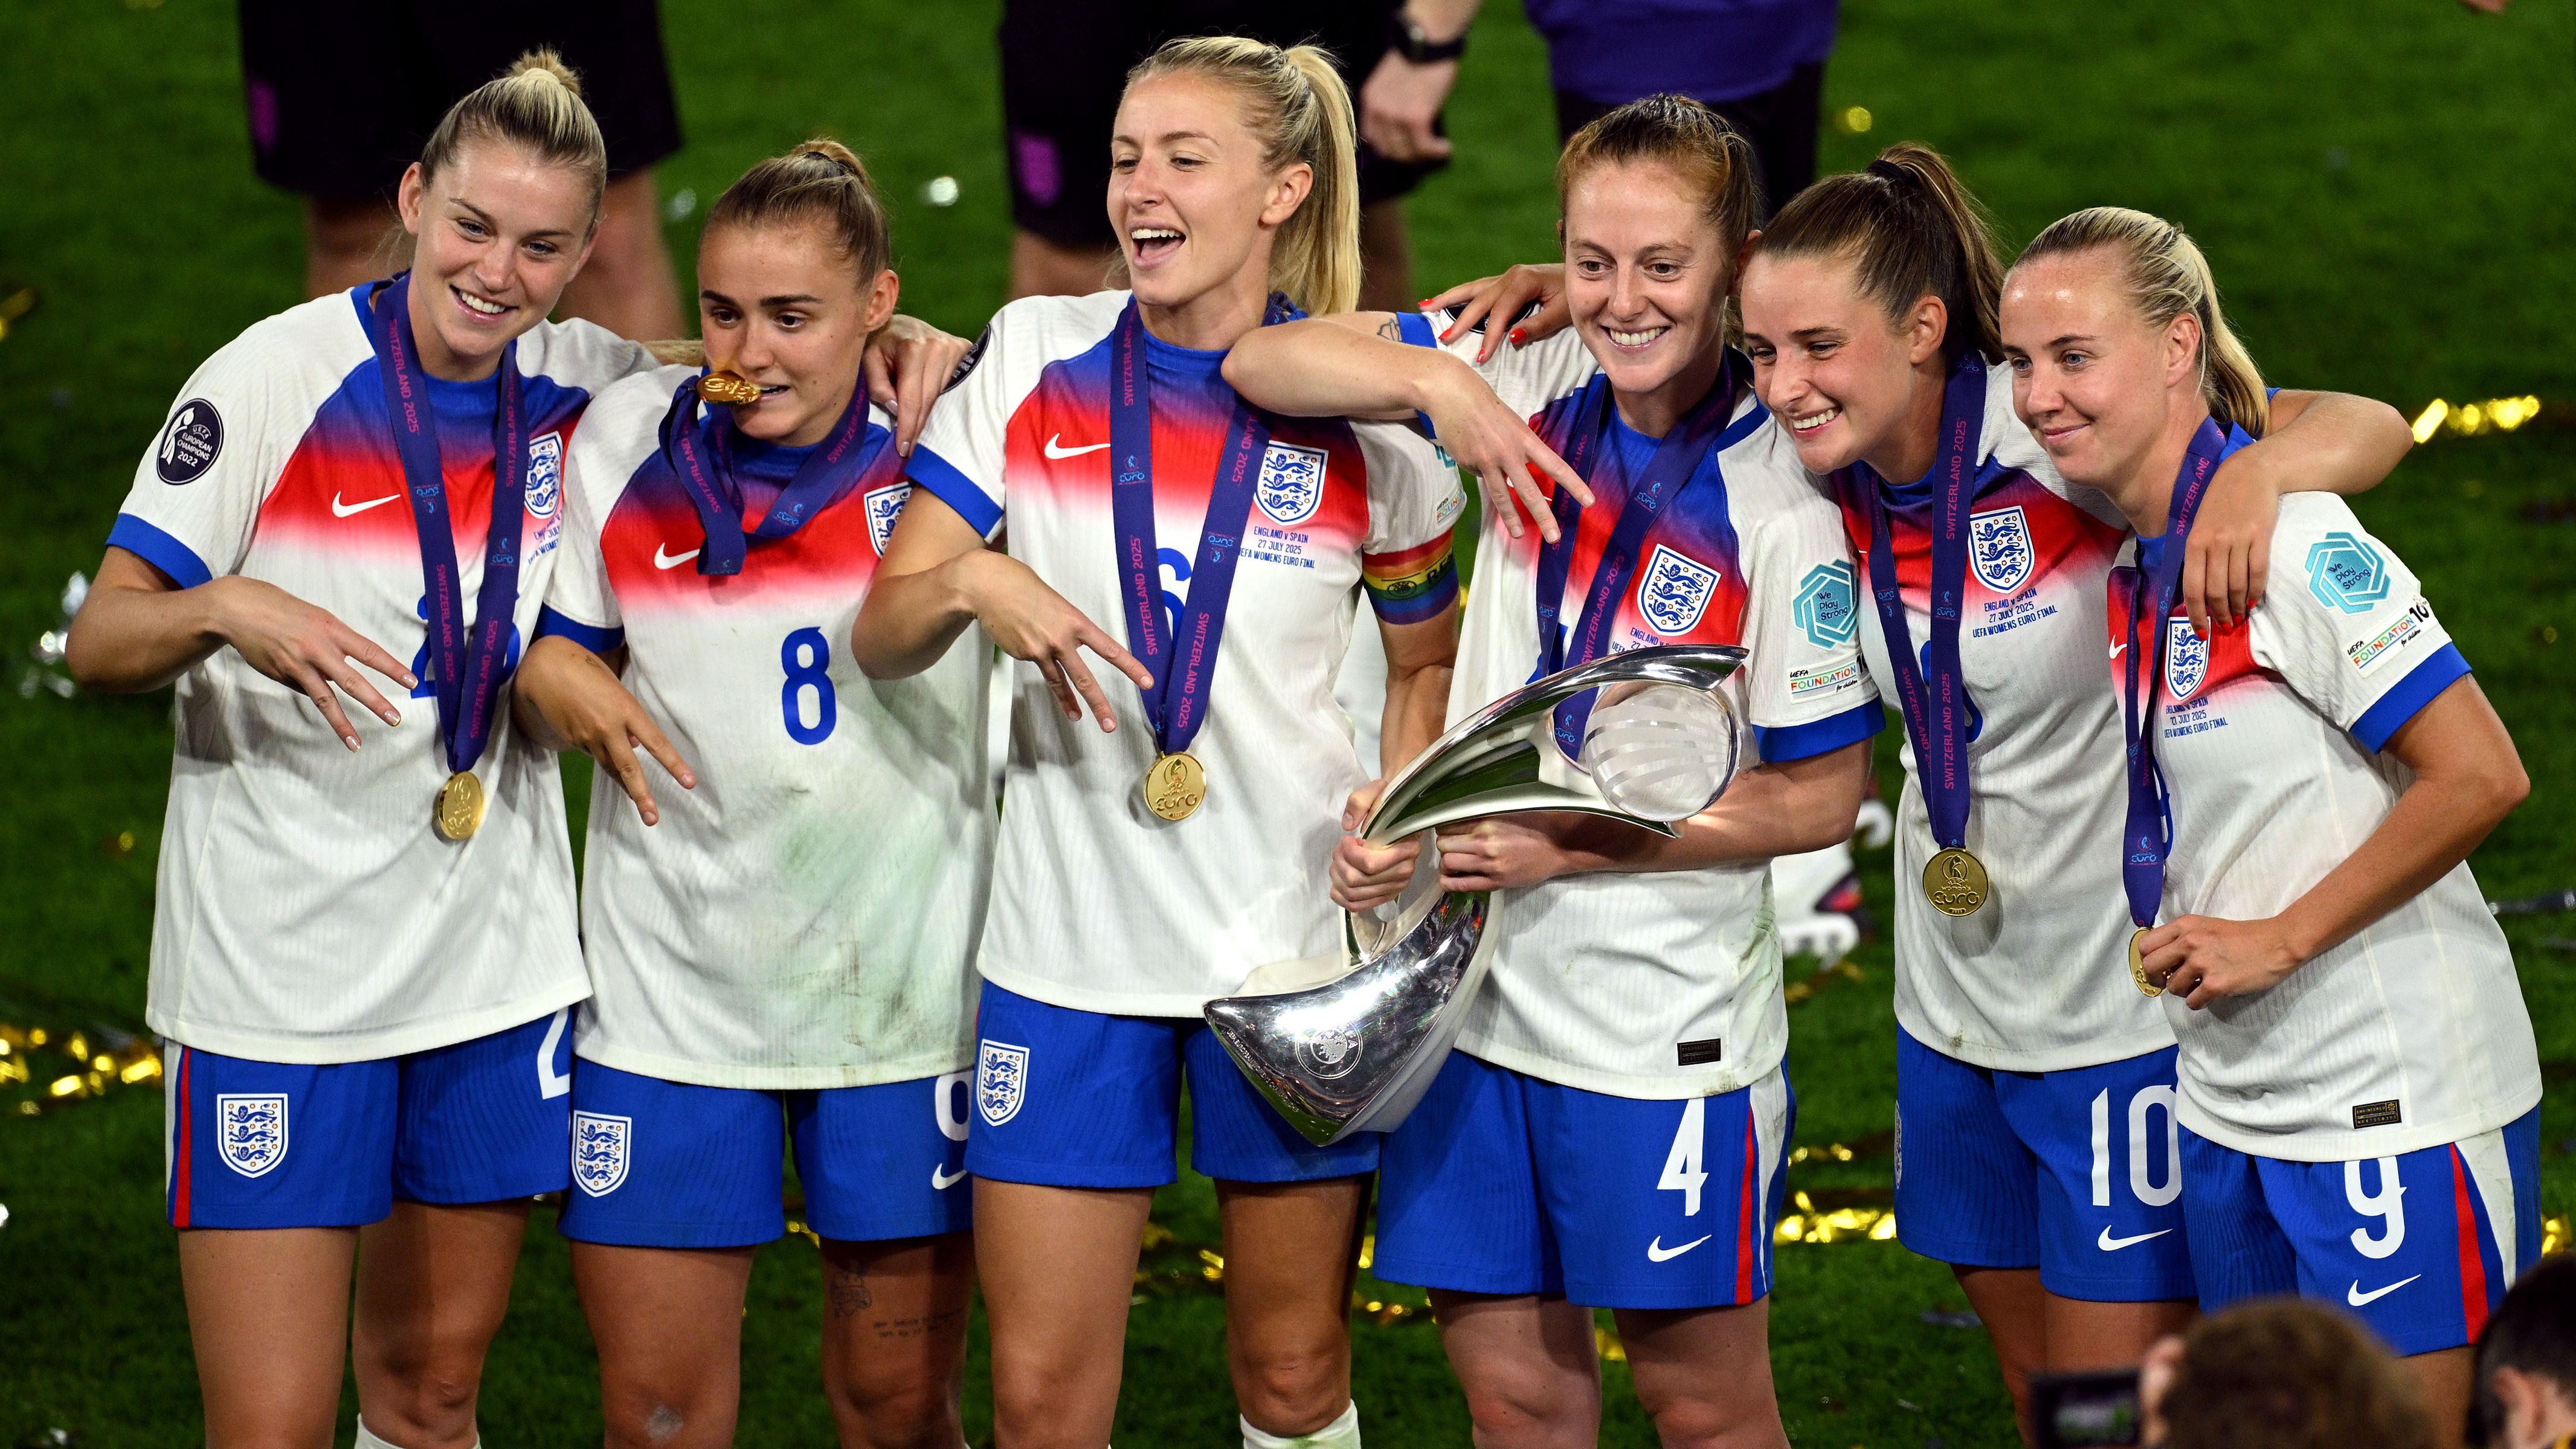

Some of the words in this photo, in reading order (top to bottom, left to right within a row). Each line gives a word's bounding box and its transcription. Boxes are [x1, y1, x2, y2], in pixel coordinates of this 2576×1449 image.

[404, 402, 419, 432] 2025
[182, 432, 213, 452] EUROPEAN
[193, 426, 209, 439] UEFA
[177, 439, 210, 461] CHAMPIONS
[178, 451, 198, 467] 2022
[1232, 452, 1248, 483] 2025
[1946, 455, 1962, 540] SWITZERLAND
[1954, 420, 1966, 452] 2025
[1254, 526, 1283, 539] ENGLAND
[1290, 532, 1309, 543] SPAIN
[1130, 537, 1143, 569] 2025
[1258, 539, 1266, 548] 27
[1268, 541, 1284, 551] JULY
[1285, 544, 1302, 554] 2025
[1240, 548, 1252, 557] EFA
[1254, 549, 1282, 563] WOMENS
[1283, 556, 1299, 566] EURO
[1299, 558, 1315, 568] FINAL
[2328, 563, 2343, 572] We
[2336, 567, 2355, 582] Play
[2343, 569, 2371, 590] Strong
[436, 564, 452, 647] SWITZERLAND
[1817, 591, 1832, 600] We
[1819, 600, 1838, 611] Play
[1984, 599, 2009, 612] ENGLAND
[2017, 588, 2038, 603] SPAIN
[1135, 573, 1158, 655] SWITZERLAND
[1582, 585, 1610, 664] SWITZERLAND
[1606, 555, 1624, 585] 2025
[1821, 606, 1848, 620] Strong
[1989, 613, 1997, 623] 27
[1998, 609, 2014, 621] JULY
[2016, 601, 2035, 614] 2025
[1972, 628, 1988, 638] UEFA
[1987, 620, 2017, 635] WOMENS
[2018, 613, 2037, 626] EURO
[2037, 605, 2058, 620] FINAL
[485, 620, 498, 651] 2025
[1630, 628, 1658, 645] ENGLAND
[1631, 641, 1640, 649] 27
[1183, 612, 1209, 694] SWITZERLAND
[2347, 640, 2365, 655] UEFA
[782, 626, 837, 745] 8
[1843, 680, 1858, 689] children
[1942, 673, 1951, 703] 2025
[1178, 697, 1192, 728] 2025
[1902, 667, 1931, 750] SWITZERLAND
[2166, 704, 2185, 714] ENGLAND
[2190, 696, 2209, 708] SPAIN
[2164, 728, 2173, 738] UEFA
[2173, 725, 2193, 737] WOMENS
[2194, 722, 2209, 733] EURO
[2209, 717, 2228, 729] FINAL
[2178, 713, 2190, 724] JULY
[2192, 710, 2207, 721] 2025
[1943, 707, 1954, 789] SWITZERLAND
[2091, 1084, 2182, 1207] 10
[1656, 1099, 1708, 1216] 4
[2344, 1157, 2407, 1259] 9
